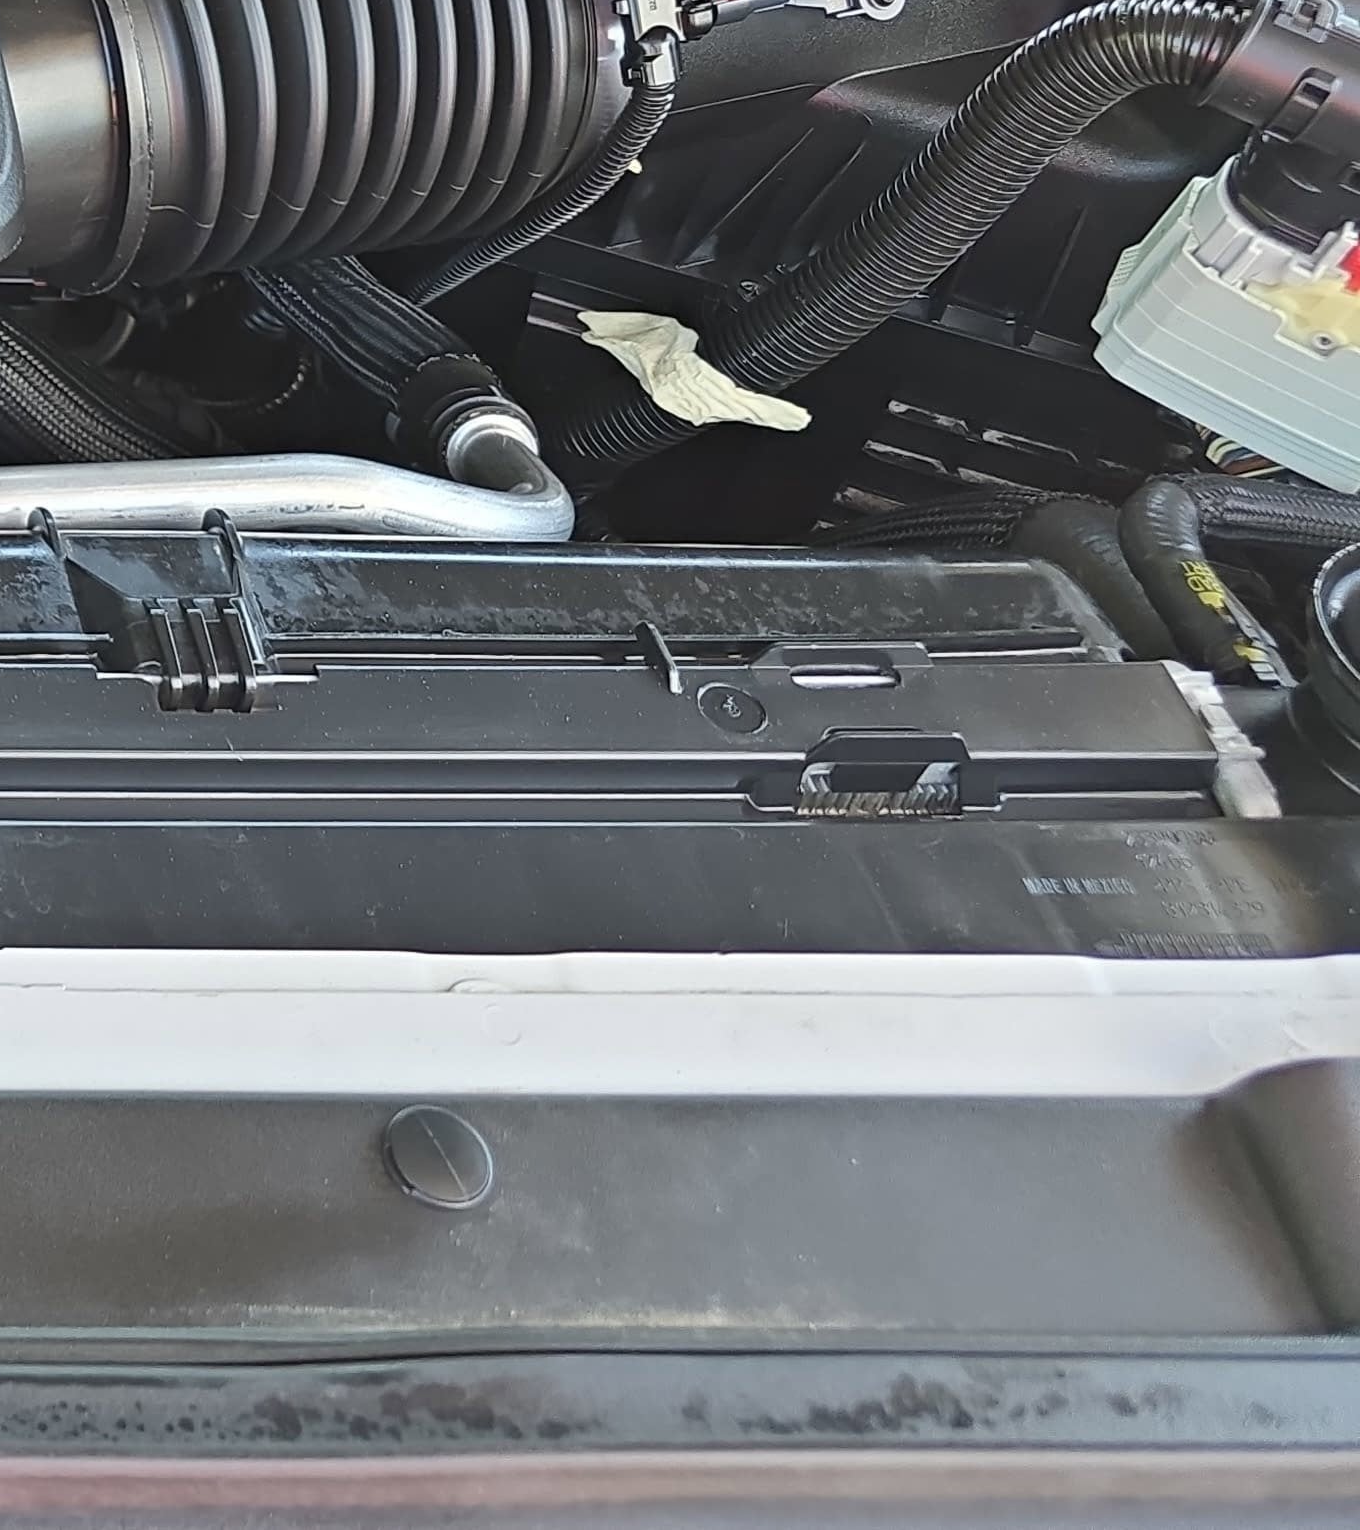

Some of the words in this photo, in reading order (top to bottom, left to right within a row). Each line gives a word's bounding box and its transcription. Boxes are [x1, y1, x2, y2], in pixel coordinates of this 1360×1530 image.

[1021, 877, 1065, 895] MADE
[1062, 877, 1082, 895] IN
[1080, 877, 1137, 895] MEXICO
